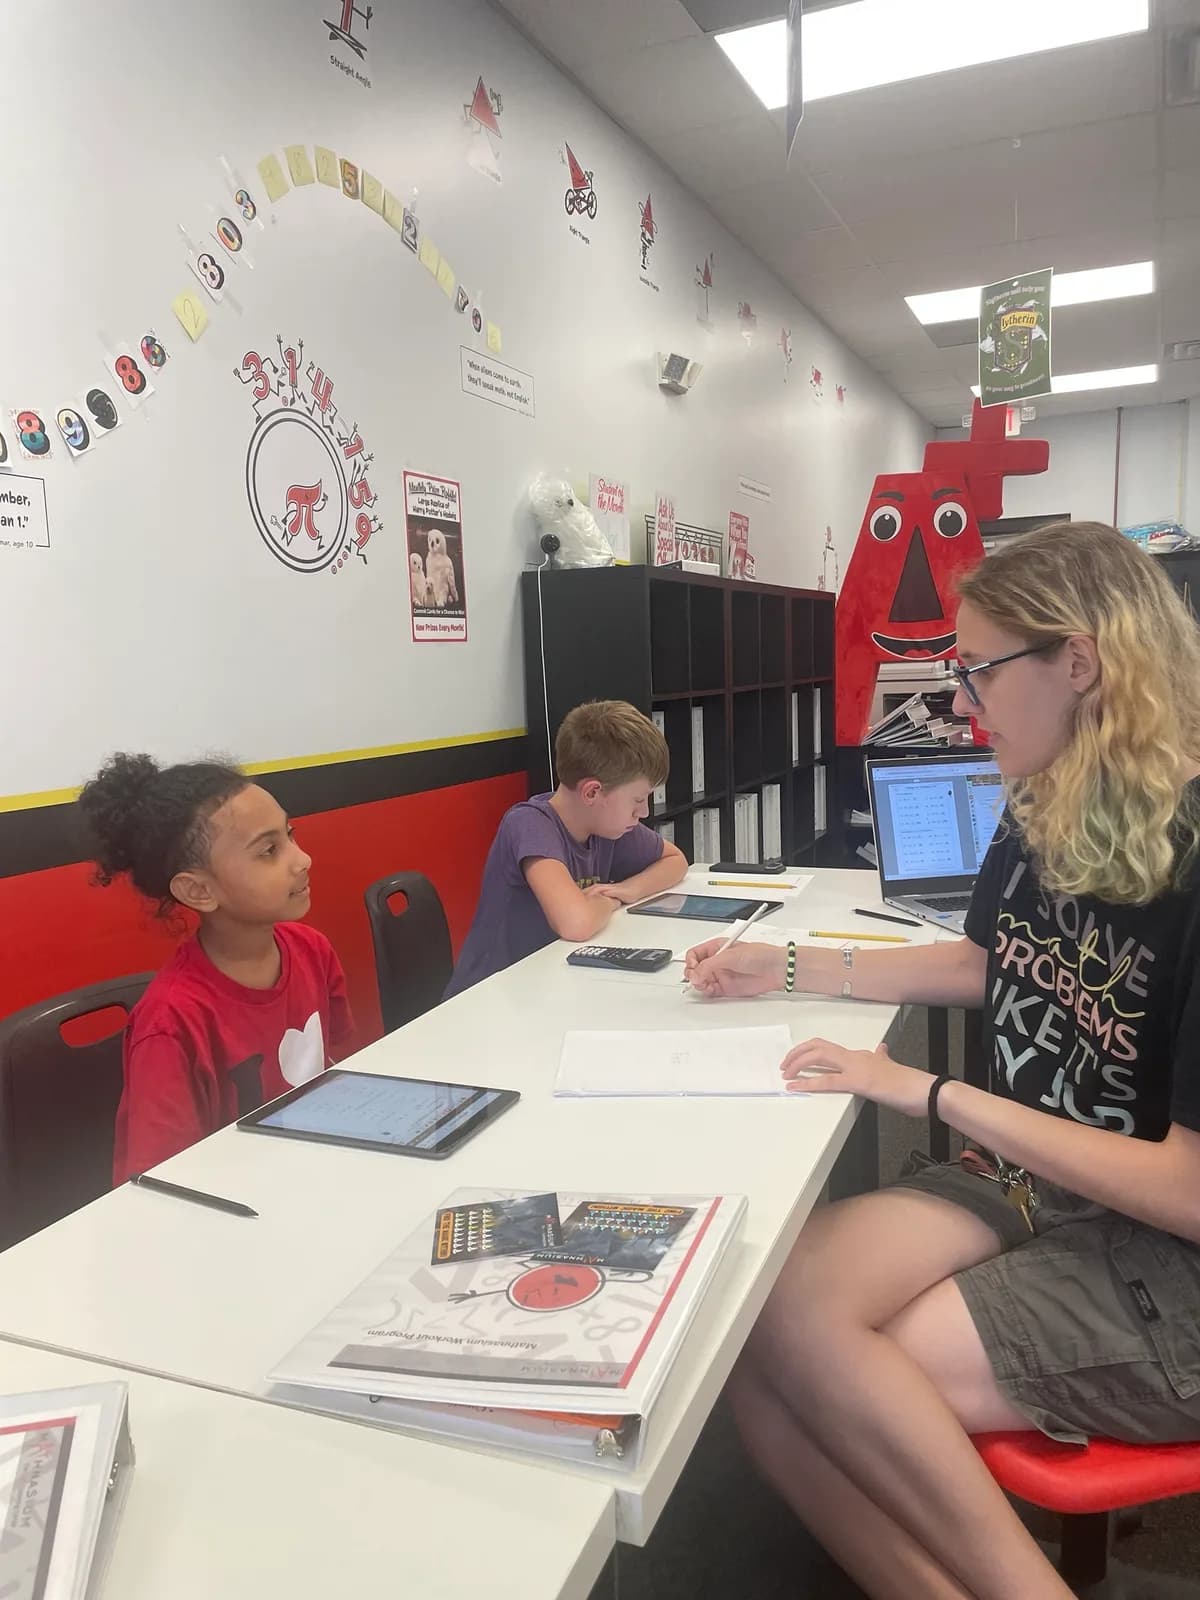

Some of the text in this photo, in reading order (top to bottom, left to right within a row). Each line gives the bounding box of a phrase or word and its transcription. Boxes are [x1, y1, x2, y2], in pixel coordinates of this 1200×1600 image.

[235, 189, 257, 220] 3
[217, 217, 243, 252] 0
[197, 253, 225, 290] 8
[115, 355, 147, 395] 8
[17, 411, 51, 456] 8
[57, 408, 90, 451] 9
[998, 907, 1146, 1019] math
[995, 930, 1138, 1062] PROBEMS
[367, 1329, 537, 1350] Mathnasium Workout Program
